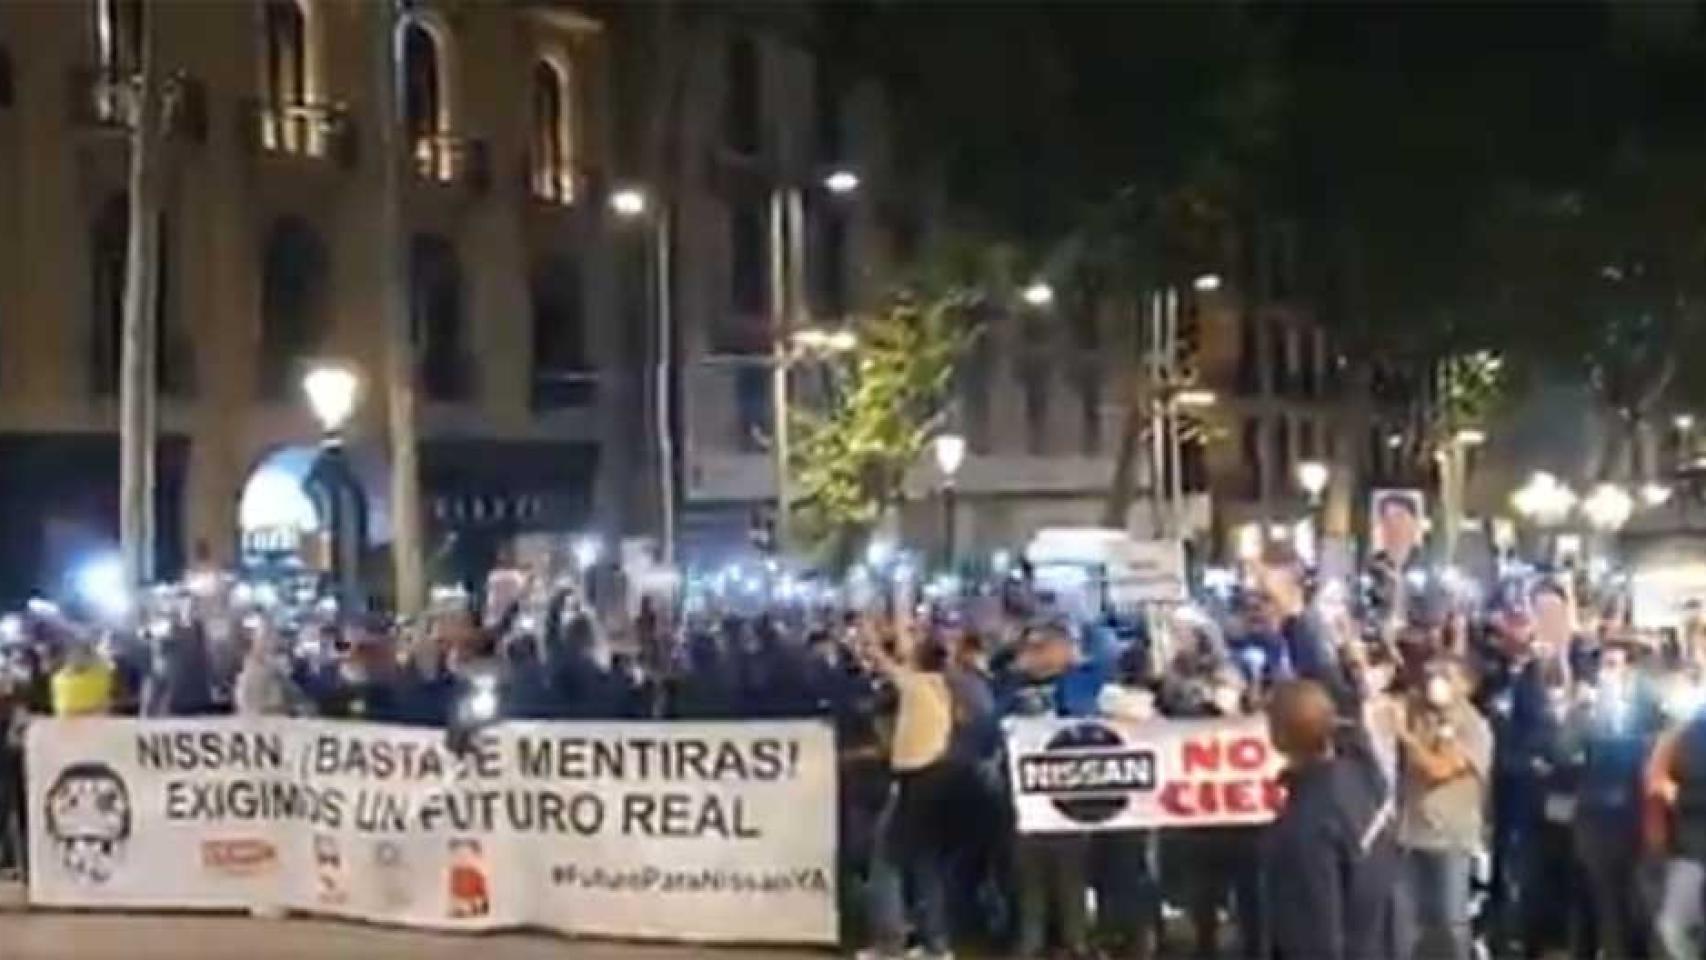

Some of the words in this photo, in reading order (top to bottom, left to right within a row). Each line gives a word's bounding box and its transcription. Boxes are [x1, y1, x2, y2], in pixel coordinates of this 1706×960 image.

[517, 738, 799, 780] MENTIRAS!
[1023, 756, 1151, 790] NISSAN
[1183, 738, 1267, 772] NO
[354, 789, 407, 834] UN
[622, 794, 762, 838] REAL
